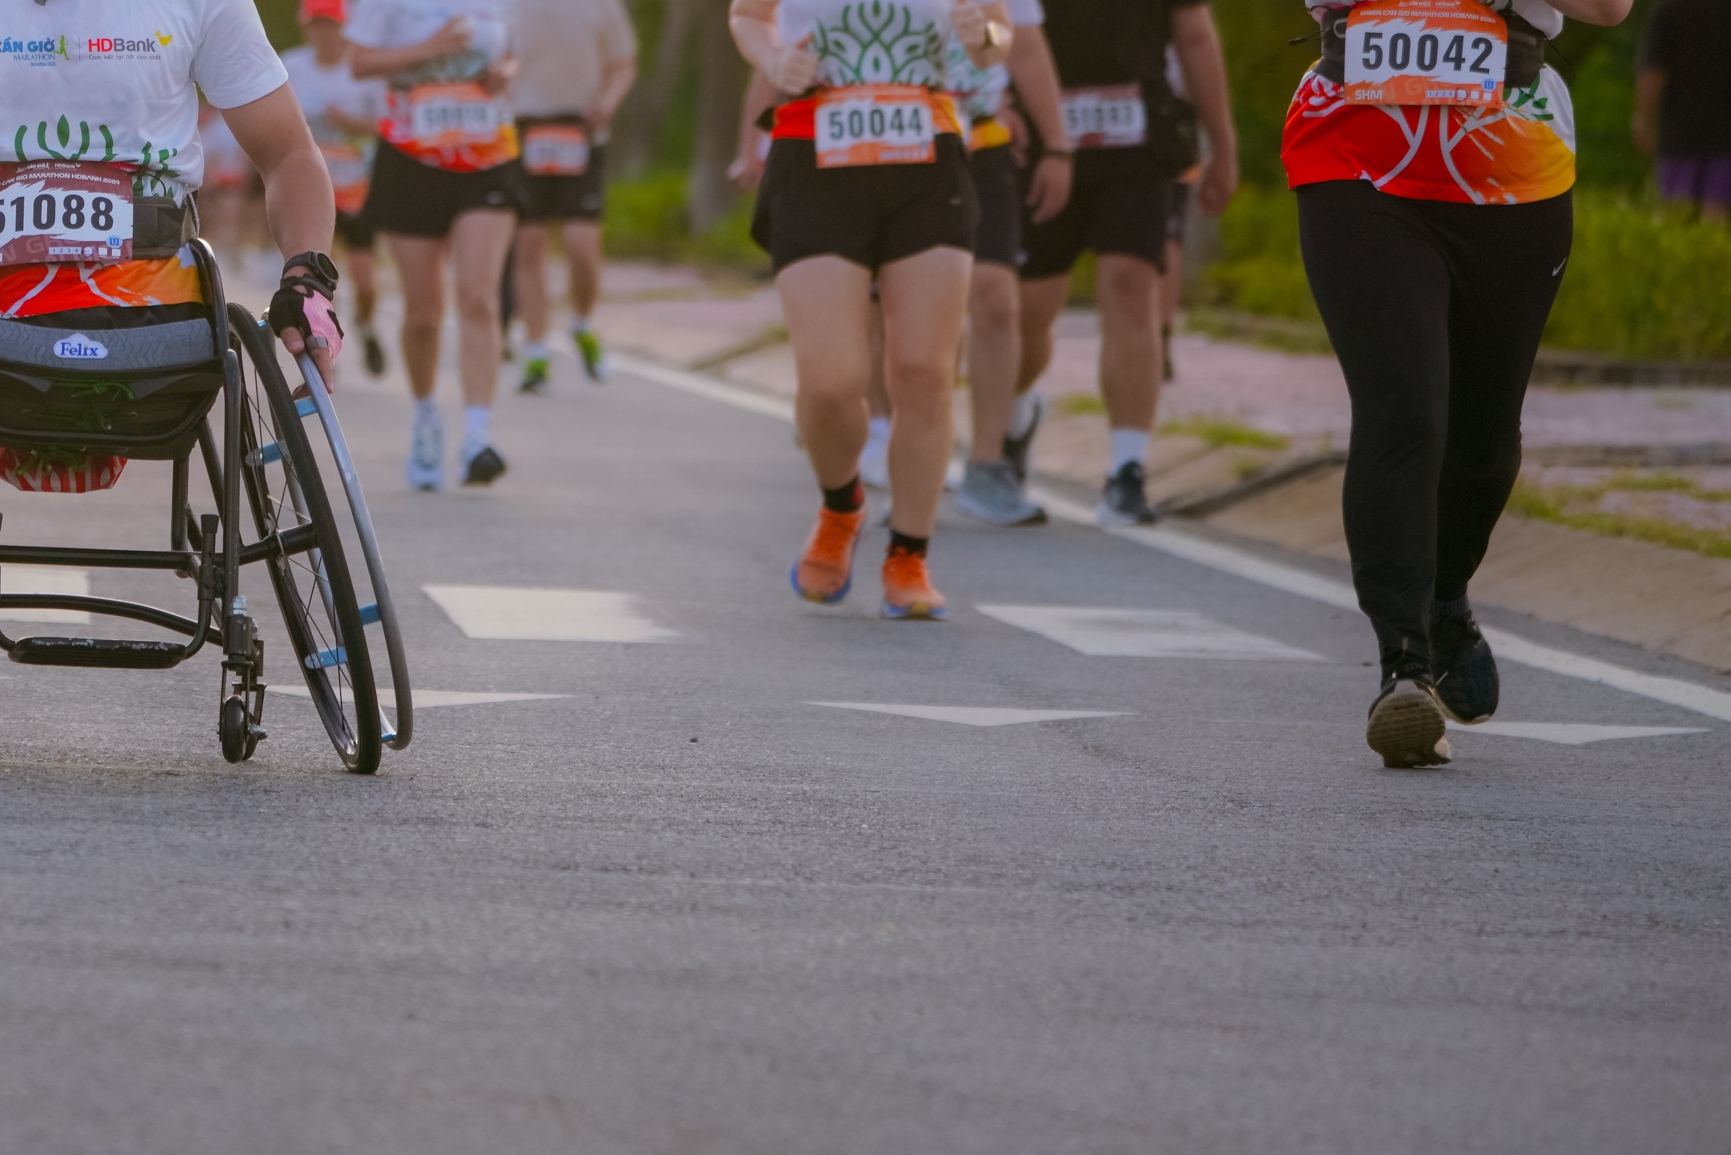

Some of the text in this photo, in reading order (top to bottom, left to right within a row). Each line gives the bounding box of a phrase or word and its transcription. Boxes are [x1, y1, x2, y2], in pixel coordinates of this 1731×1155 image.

[27, 38, 55, 53] GIỜ
[88, 38, 156, 52] HDBank
[1362, 32, 1493, 74] 50042
[829, 108, 923, 140] 50044
[2, 178, 15, 186] CAN
[60, 342, 99, 356] Felix
